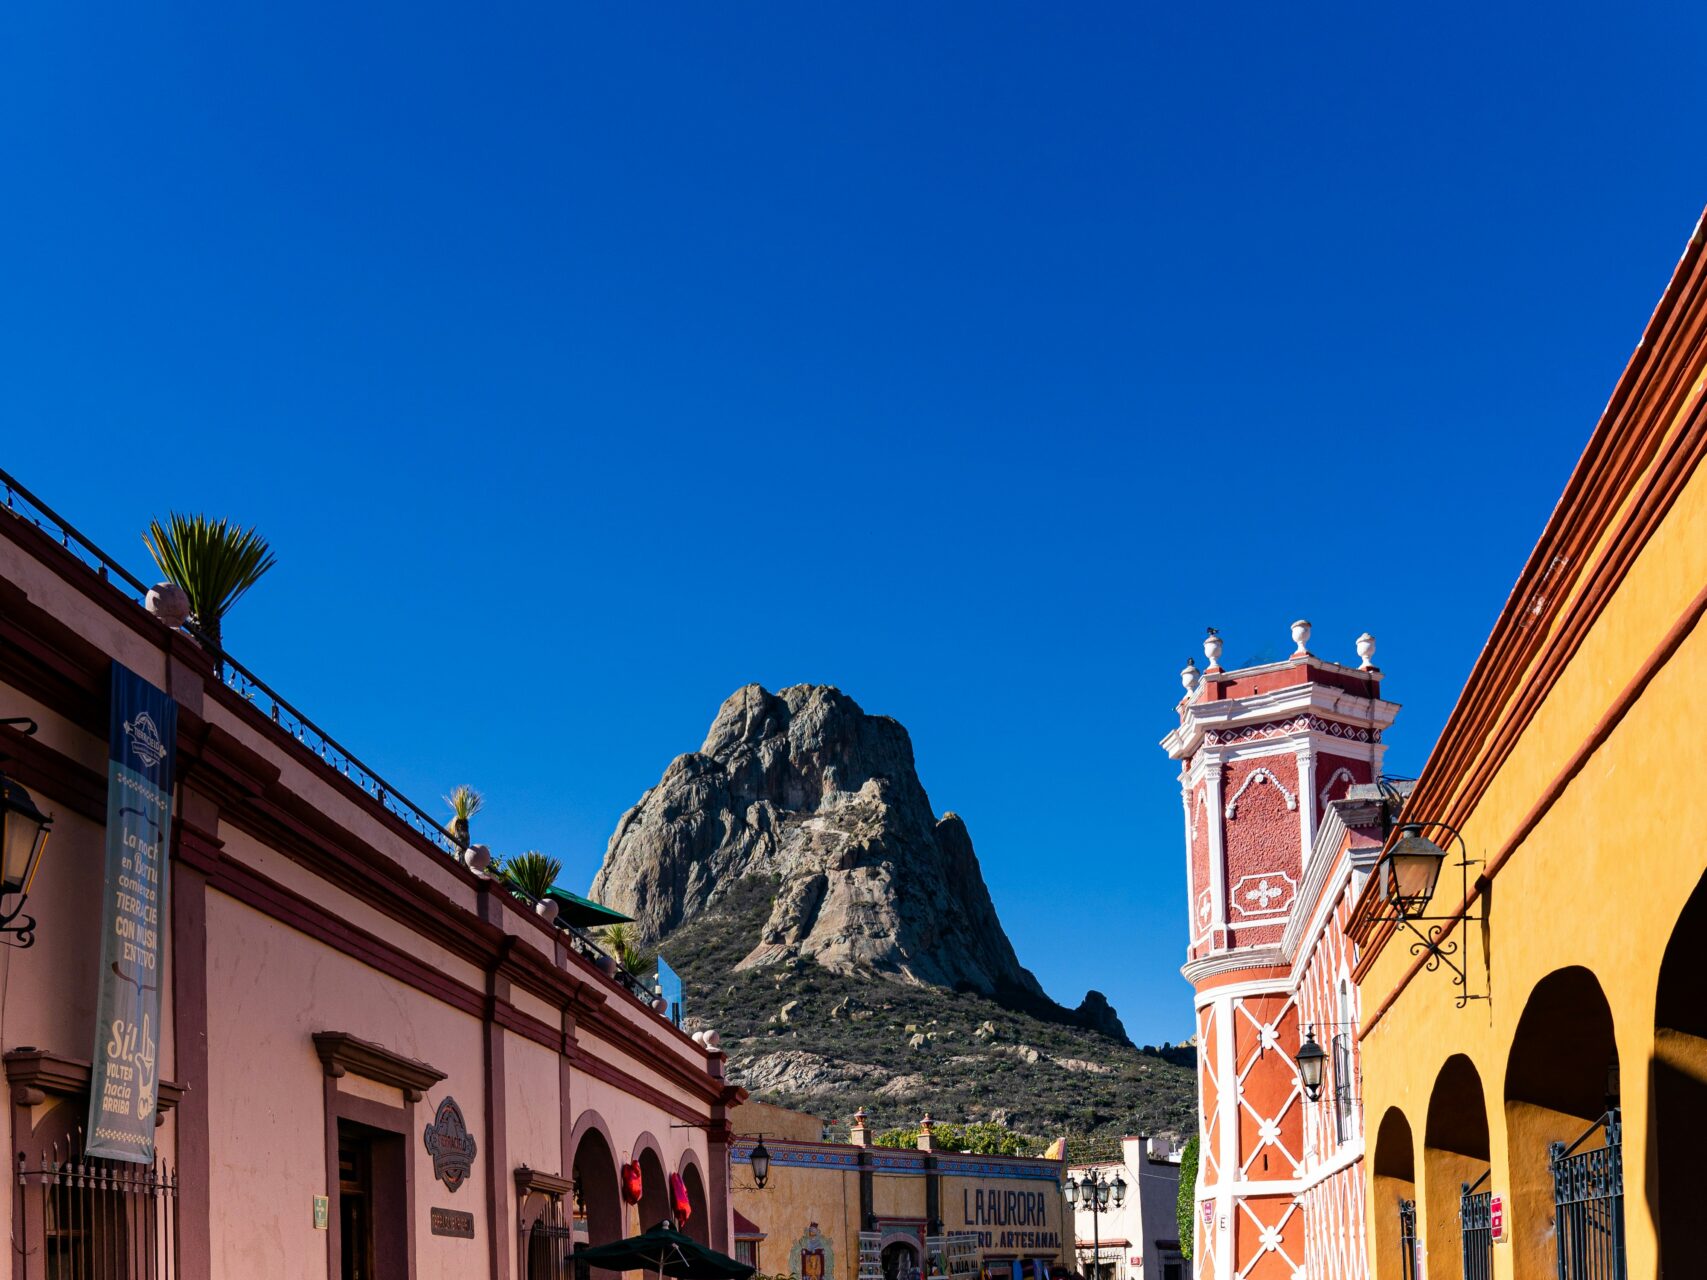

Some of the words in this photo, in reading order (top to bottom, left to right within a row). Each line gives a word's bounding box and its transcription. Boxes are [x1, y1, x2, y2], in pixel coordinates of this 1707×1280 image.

[123, 827, 137, 849] La
[138, 838, 158, 861] noch
[122, 856, 132, 871] en
[118, 874, 156, 901] comienza
[116, 891, 157, 924] TIERRACIE
[115, 915, 135, 940] CON
[123, 941, 136, 962] EN
[137, 947, 155, 970] VIVO
[107, 1019, 138, 1062] Sí!
[106, 1062, 133, 1082] VOLTEA
[104, 1079, 131, 1098] hacia
[102, 1095, 130, 1116] ARRIBA
[988, 1189, 1046, 1226] AURORA
[1000, 1231, 1061, 1248] ARTESANAL
